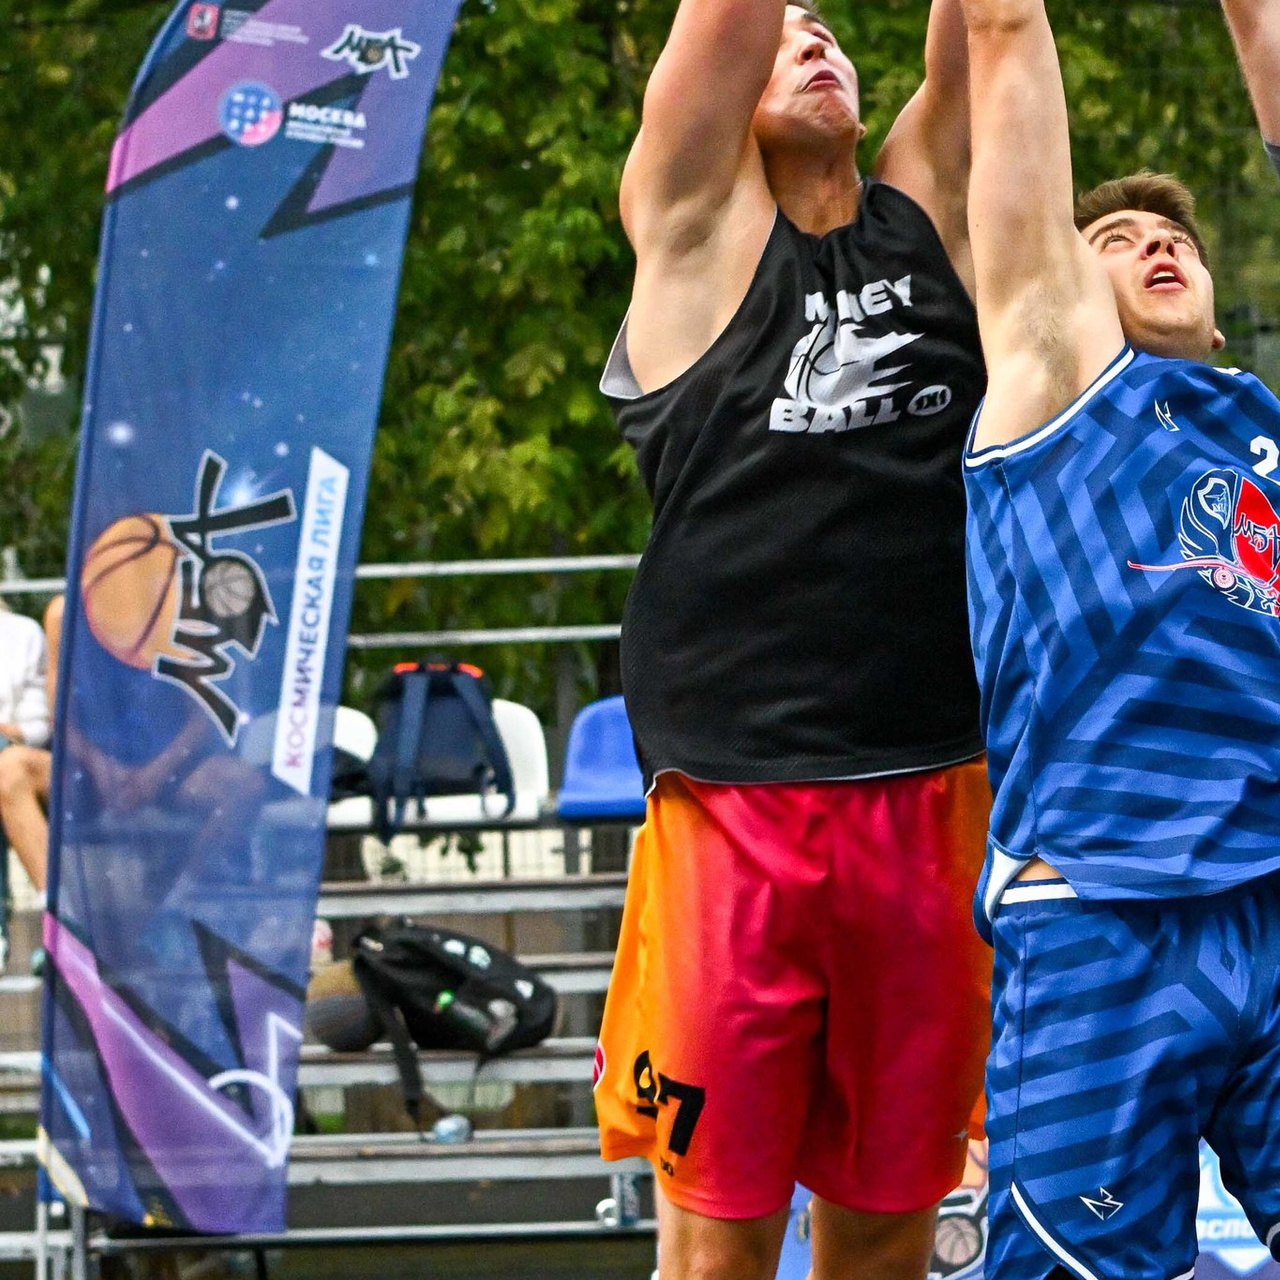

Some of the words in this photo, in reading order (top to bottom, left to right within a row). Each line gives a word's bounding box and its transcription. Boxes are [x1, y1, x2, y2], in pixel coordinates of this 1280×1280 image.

[768, 396, 902, 434] BALL
[285, 556, 324, 768] КОСМИЧЕСКАЯ
[312, 475, 339, 547] ЛИГА
